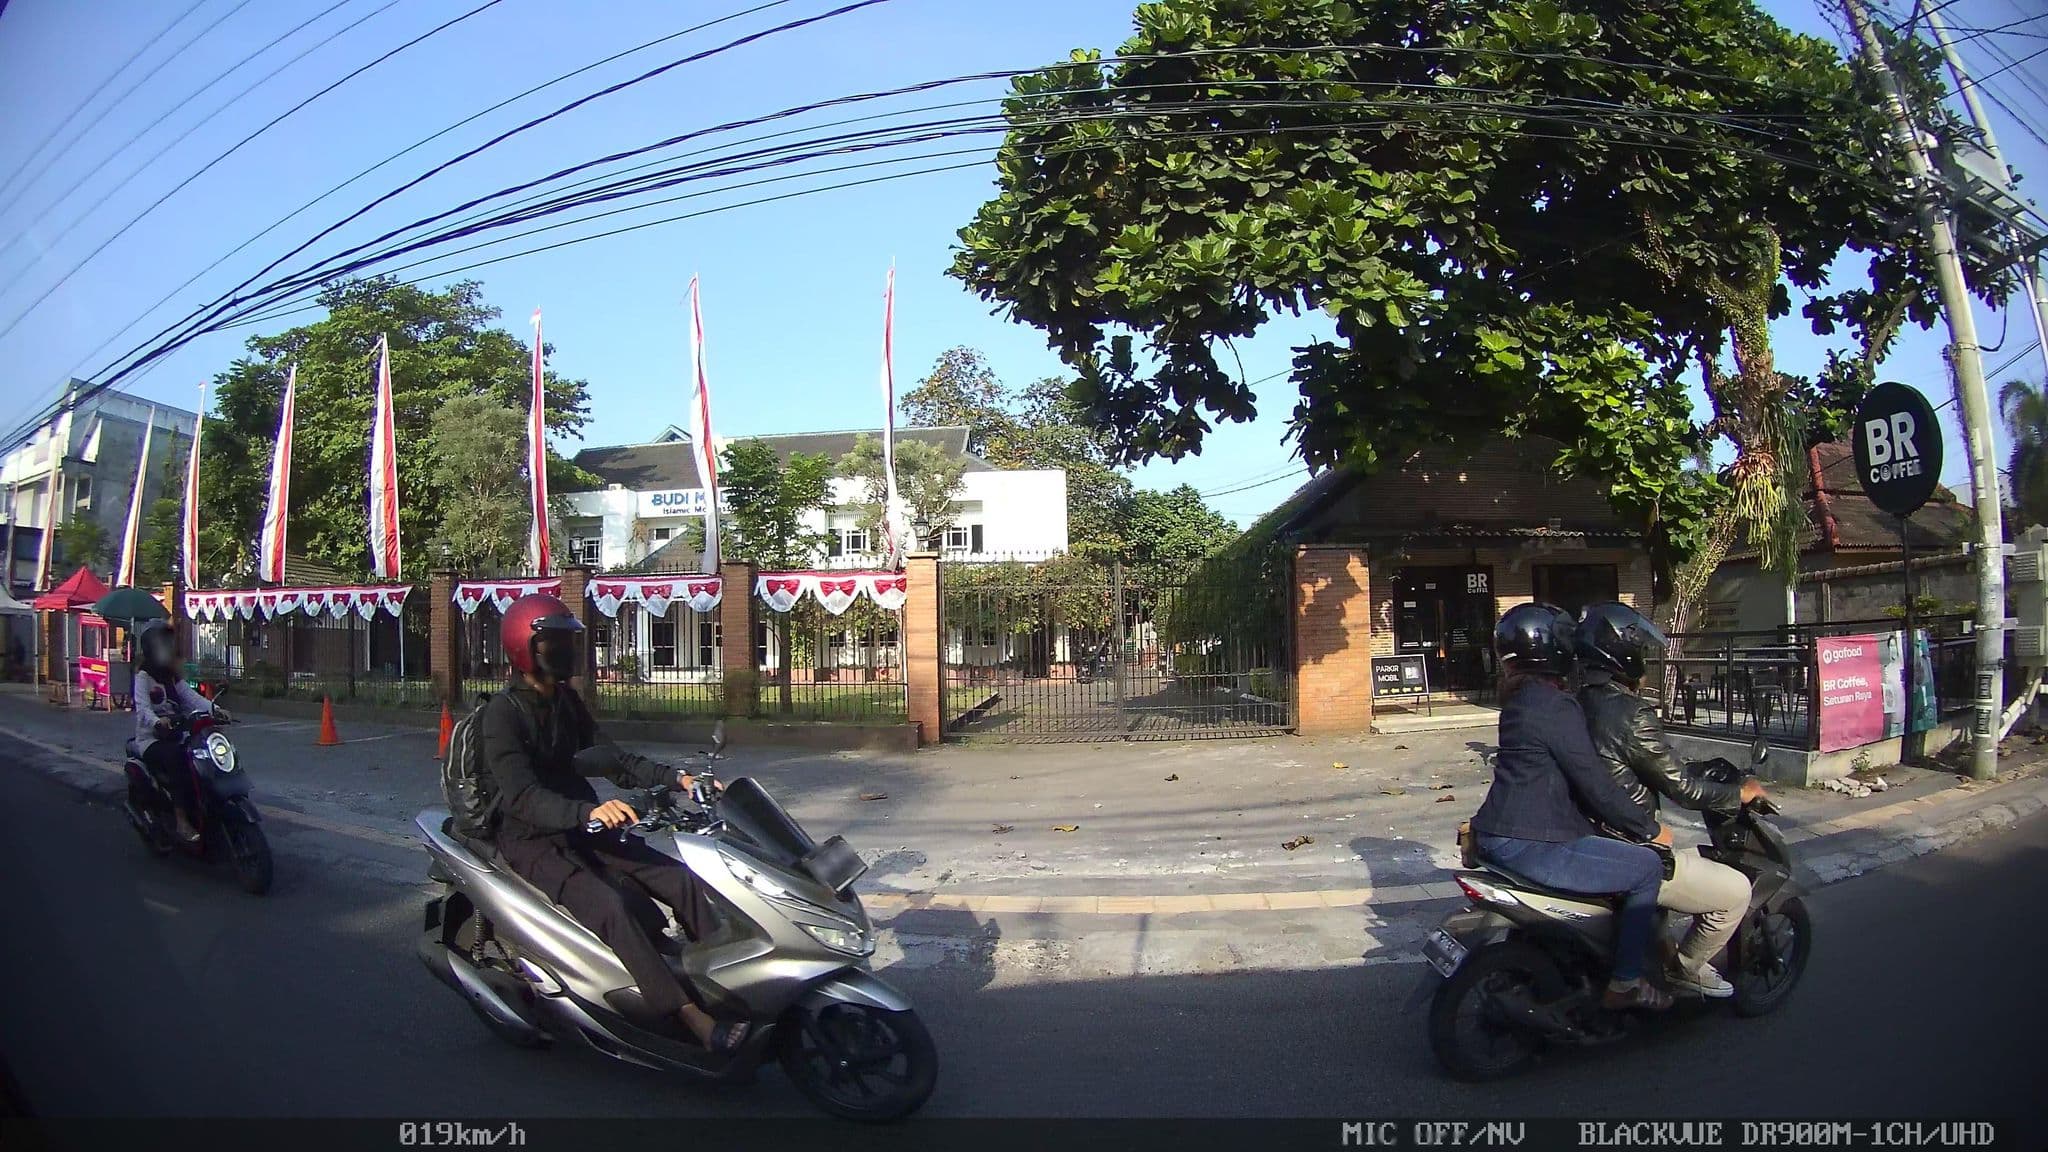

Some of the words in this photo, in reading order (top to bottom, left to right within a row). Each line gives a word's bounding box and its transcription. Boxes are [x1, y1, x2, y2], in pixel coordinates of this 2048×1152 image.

[1865, 411, 1919, 466] BR
[652, 492, 689, 506] BUDI
[1467, 573, 1487, 588] BR
[1833, 645, 1862, 662] gofood
[1375, 664, 1399, 672] PARKIR
[1377, 674, 1399, 682] MOBIL
[1823, 679, 1835, 691] BR
[1837, 676, 1868, 689] Coffee,
[1854, 691, 1872, 702] Raya
